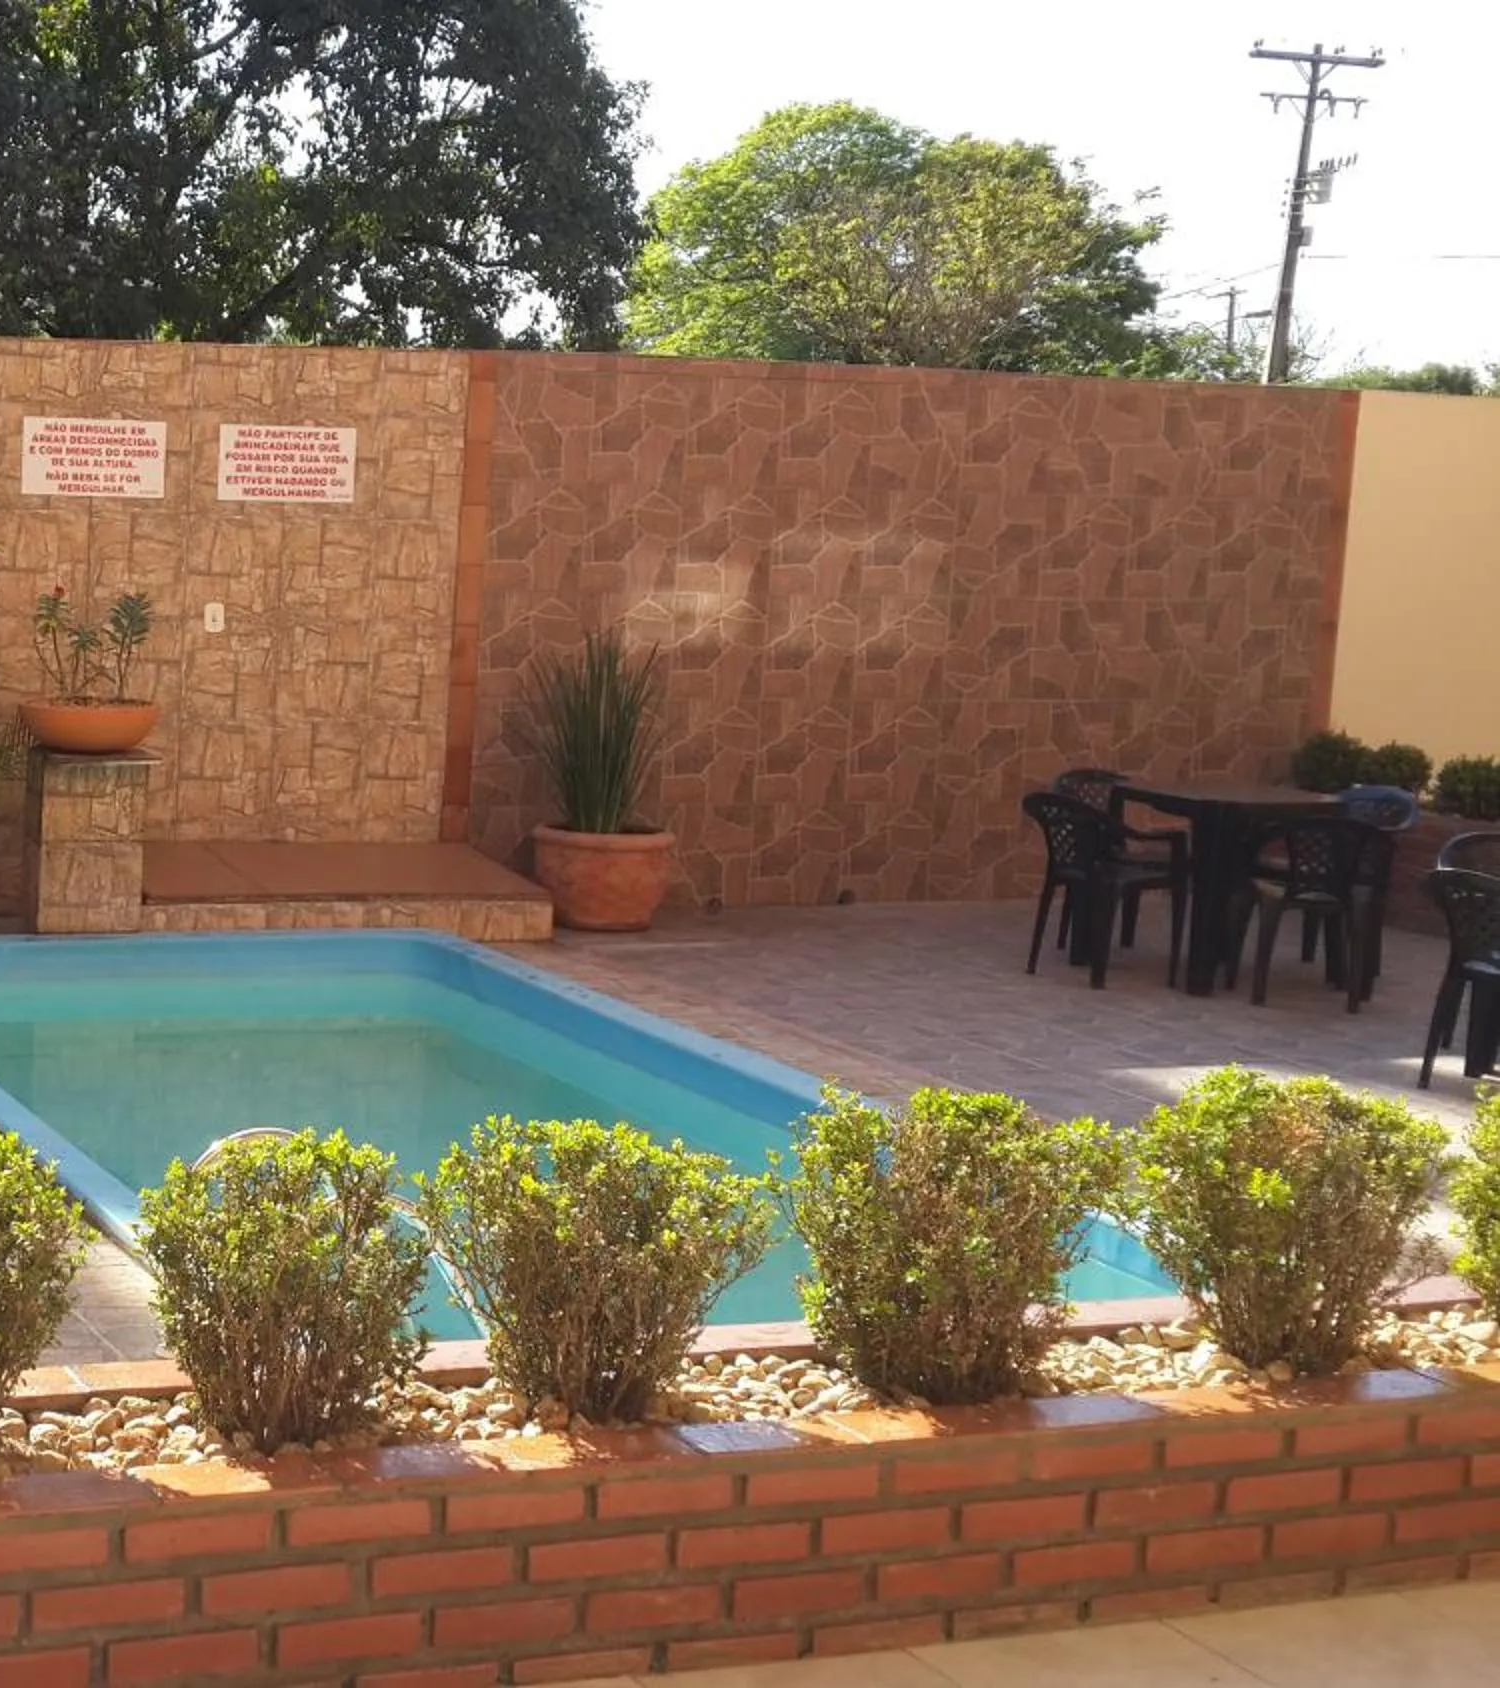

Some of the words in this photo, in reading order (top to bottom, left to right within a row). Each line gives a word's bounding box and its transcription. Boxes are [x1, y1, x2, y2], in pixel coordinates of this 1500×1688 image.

[44, 423, 66, 432] NÃO
[238, 429, 262, 438] NÃO
[265, 430, 320, 440] PARTICIPE
[324, 432, 338, 440] DE
[70, 437, 157, 446] DESCONHECIDAS
[29, 446, 36, 454] E
[39, 446, 62, 455] COM
[66, 448, 102, 456] MENOS
[106, 449, 120, 457] DO
[124, 449, 158, 458] DOBRO
[318, 443, 340, 452] QUE
[51, 458, 64, 466] DE
[69, 459, 90, 467] SUA
[226, 452, 270, 461] POSSAM
[274, 454, 295, 462] POR
[299, 455, 320, 463] SUA
[324, 456, 348, 464] VIDA
[236, 464, 251, 472] EM
[255, 465, 288, 473] RISCO
[292, 466, 337, 475] QUANDO
[46, 471, 68, 480] NÃO
[104, 473, 117, 482] SE
[120, 474, 140, 483] FOR
[226, 476, 272, 485] ESTIVER
[276, 477, 327, 486] NADANDO
